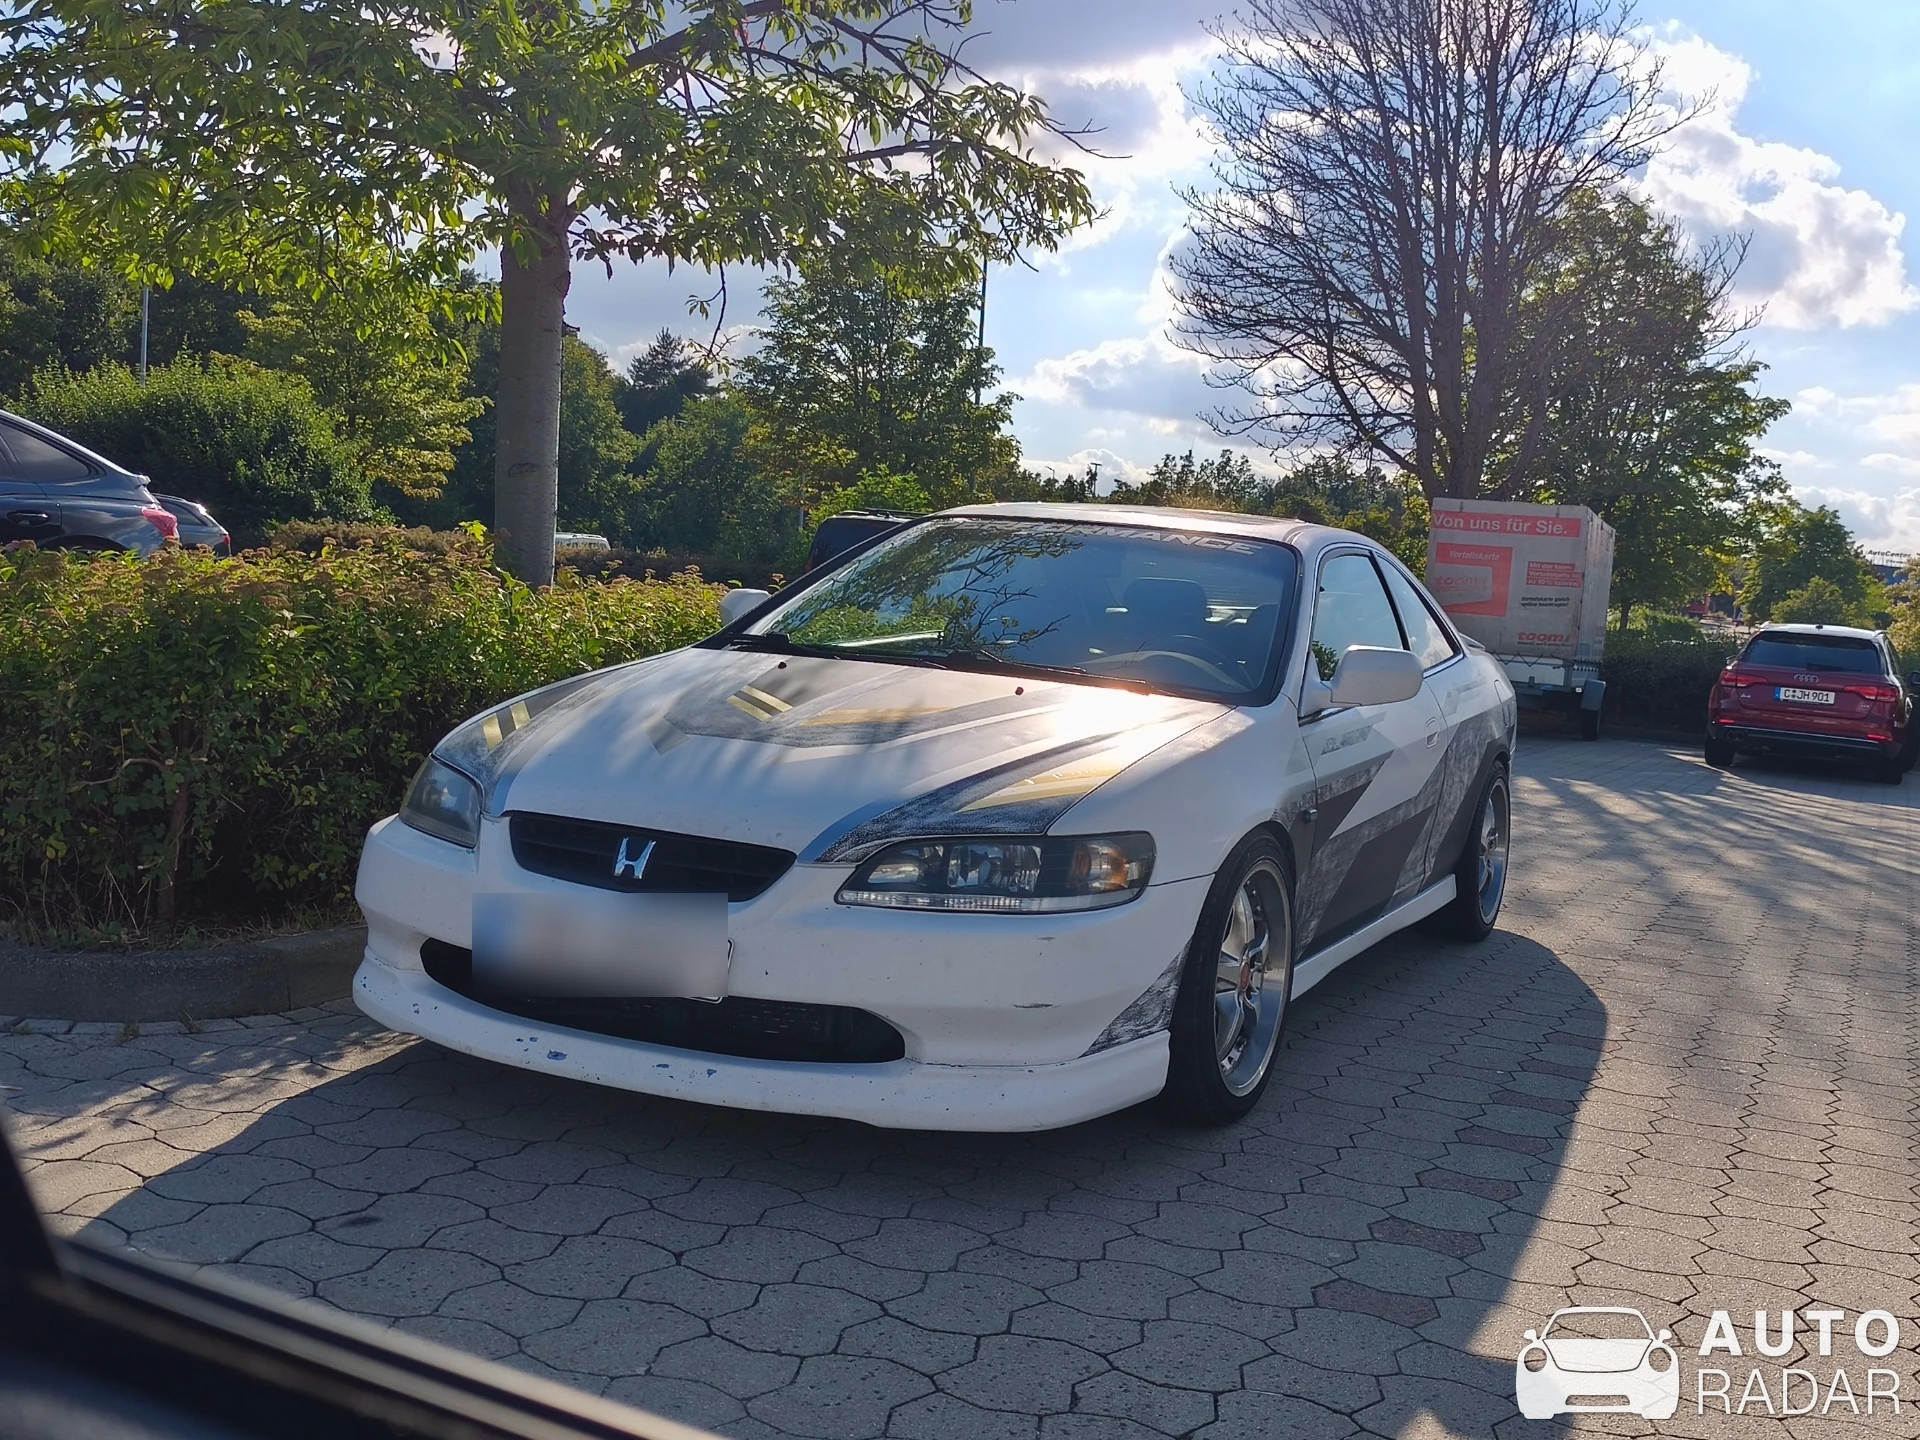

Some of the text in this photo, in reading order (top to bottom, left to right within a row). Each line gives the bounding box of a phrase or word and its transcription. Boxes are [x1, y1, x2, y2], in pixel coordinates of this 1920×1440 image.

[1434, 513, 1568, 535] Von uns für Sie.
[1449, 550, 1500, 561] Vorteilskarte
[1517, 632, 1565, 642] toom
[1783, 688, 1830, 702] C JH 901
